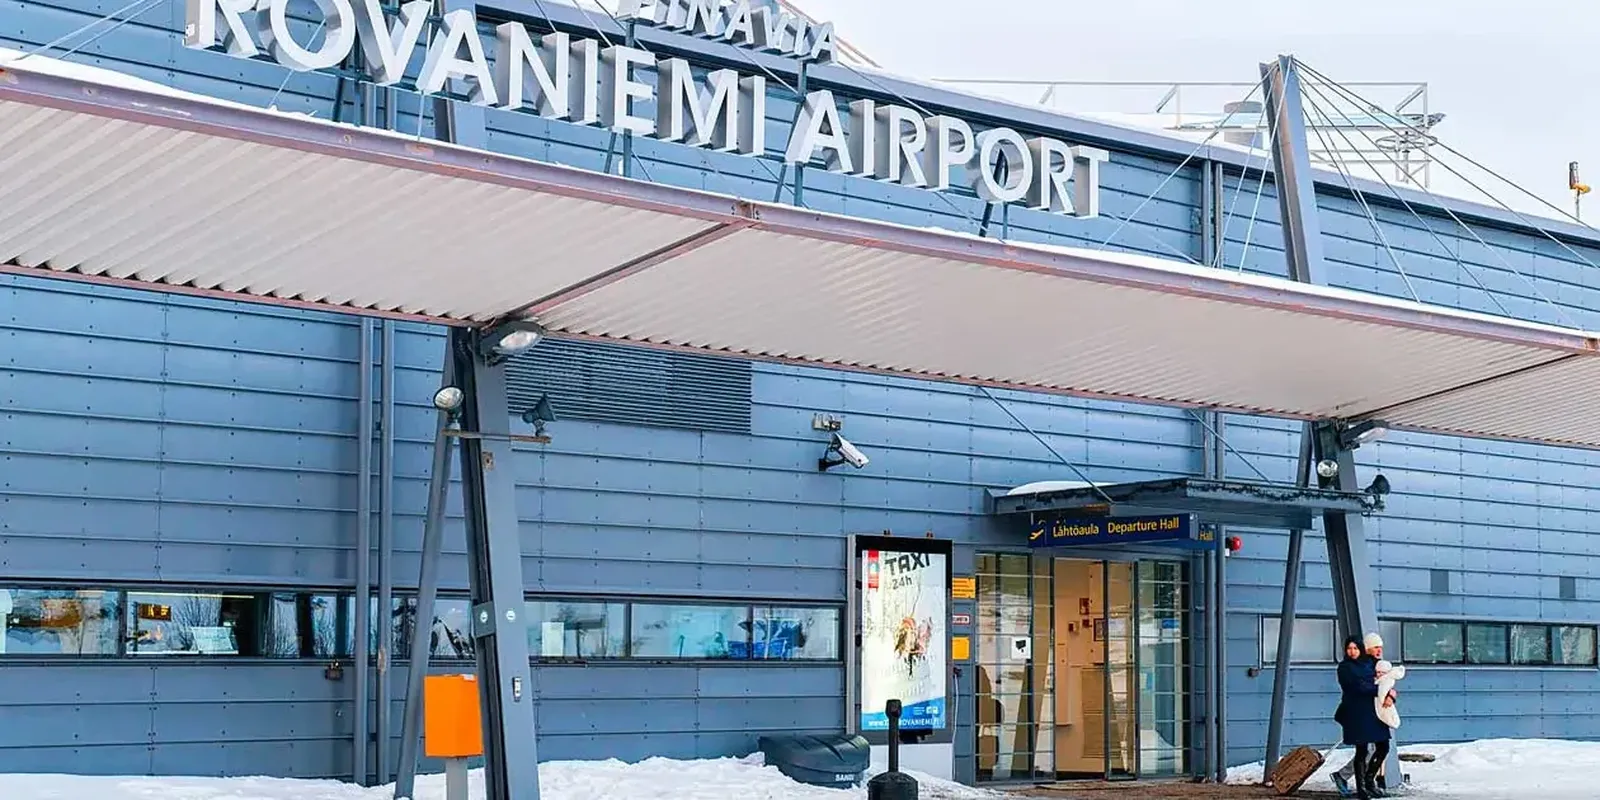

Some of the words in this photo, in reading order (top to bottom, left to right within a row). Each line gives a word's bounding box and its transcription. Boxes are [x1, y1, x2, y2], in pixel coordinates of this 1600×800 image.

[185, 0, 766, 157] ROVANIEMI
[785, 90, 1109, 218] AIRPORT
[1107, 518, 1158, 535] Departure
[1160, 516, 1180, 530] Hall
[884, 552, 931, 576] TAXI
[892, 576, 913, 590] 24h
